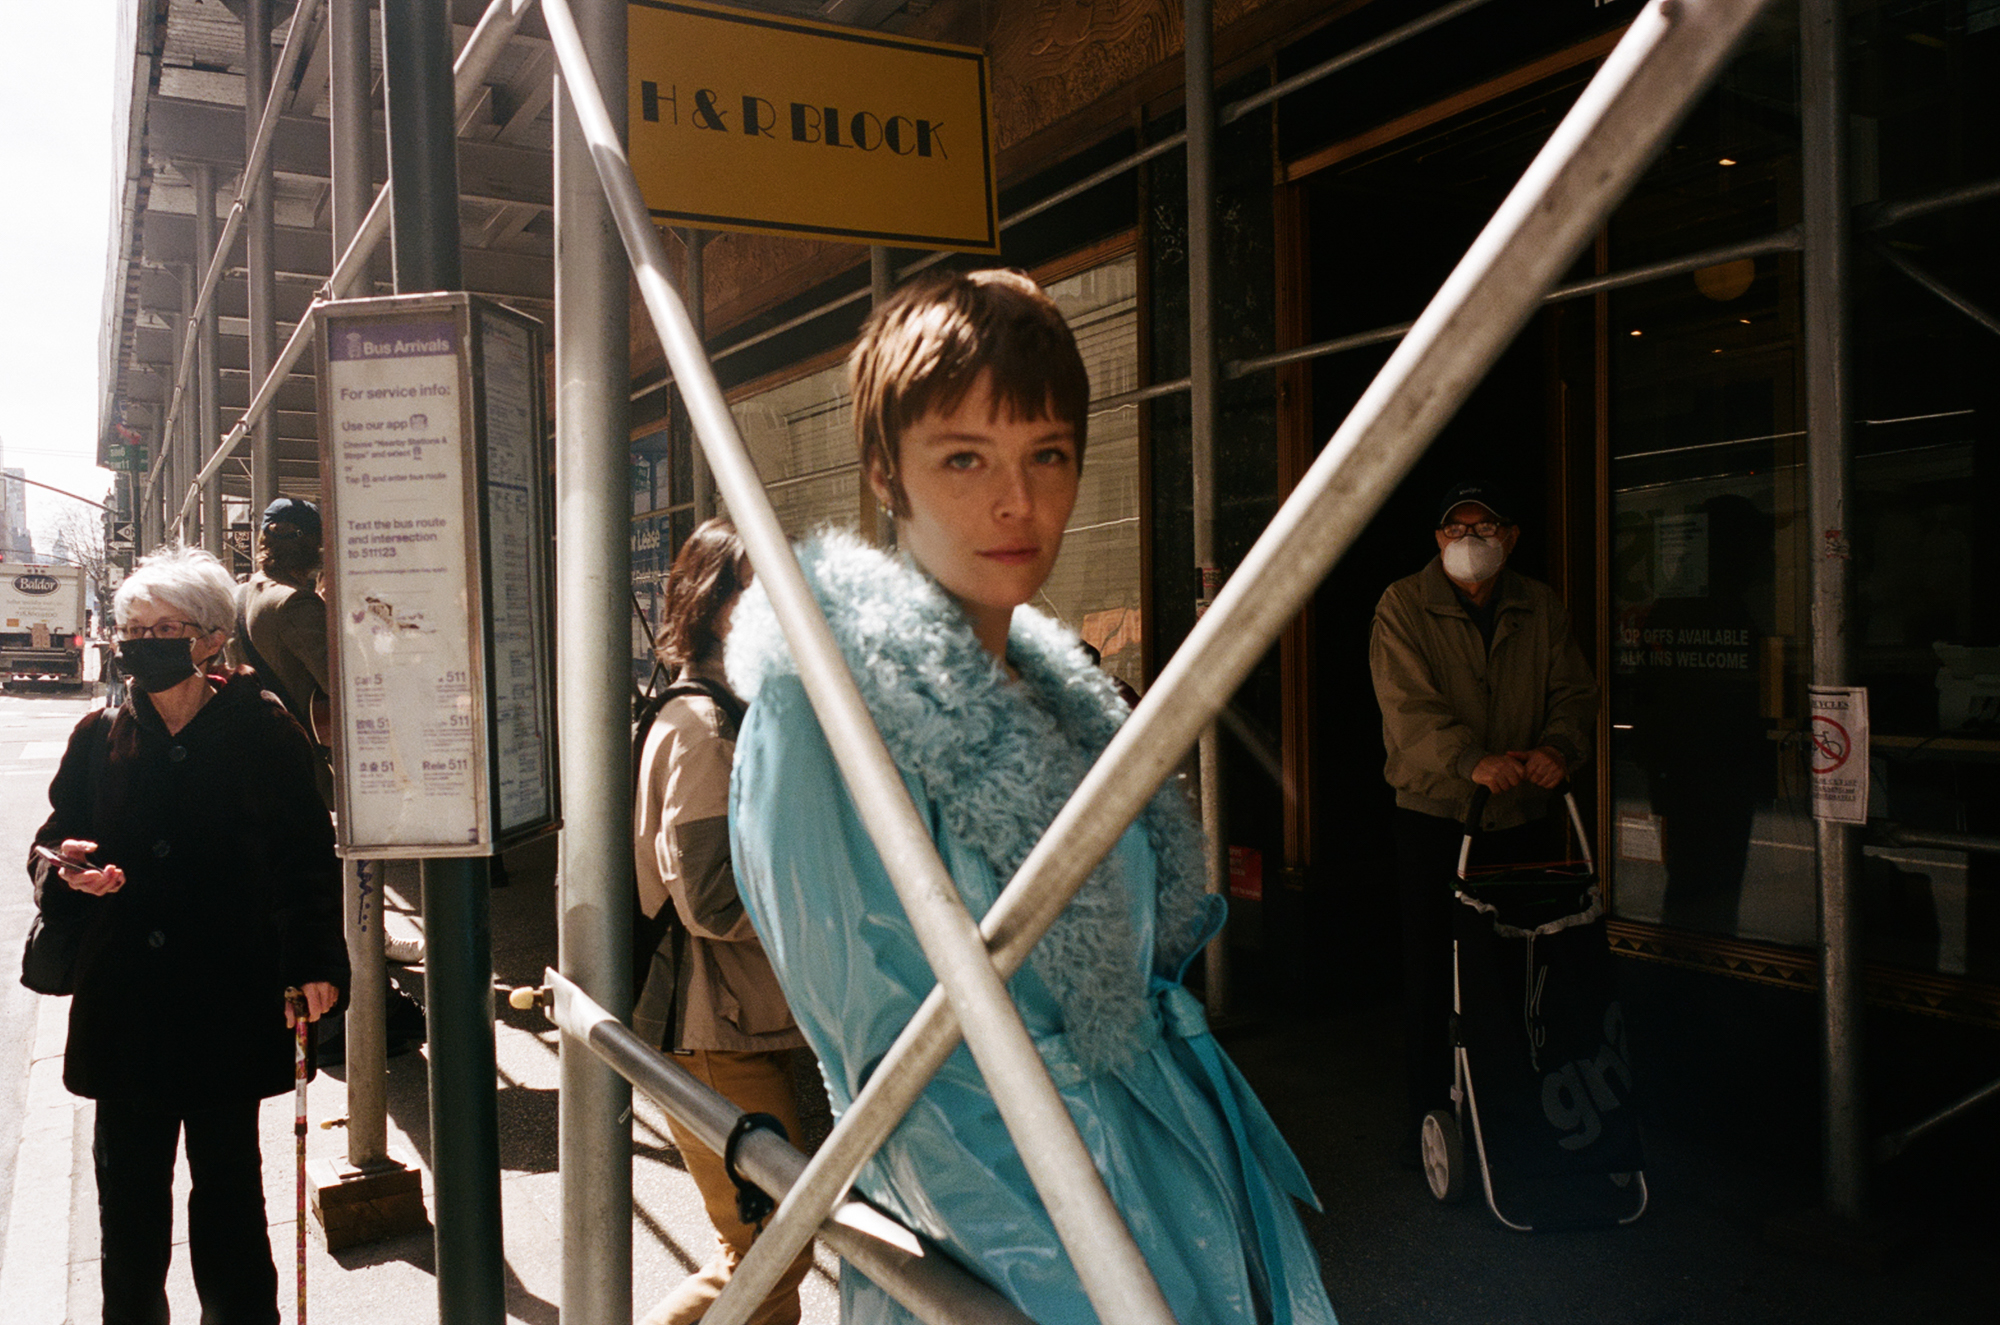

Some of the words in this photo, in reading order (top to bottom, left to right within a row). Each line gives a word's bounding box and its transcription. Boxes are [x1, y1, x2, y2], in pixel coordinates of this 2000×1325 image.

[641, 80, 678, 125] H
[692, 88, 728, 132] &
[741, 94, 777, 139] R
[790, 101, 949, 160] BLOCK
[363, 341, 392, 356] Bus
[394, 338, 450, 353] Arrivals
[341, 388, 363, 400] For
[366, 386, 416, 399] service
[419, 384, 451, 397] info:
[342, 421, 363, 431] Use
[365, 421, 384, 430] our
[386, 420, 408, 431] app
[348, 519, 373, 530] Text
[373, 518, 392, 529] the
[393, 518, 414, 528] bus
[416, 517, 447, 528] route
[348, 534, 369, 545] and
[371, 532, 438, 543] intersection
[348, 548, 359, 559] to
[20, 577, 57, 591] Baldor
[1643, 627, 1674, 645] OFFS
[1677, 628, 1749, 646] AVAILABLE
[1619, 650, 1646, 667] ALK
[1649, 651, 1673, 667] INS
[1676, 652, 1749, 669] WELCOME
[448, 759, 467, 770] 511
